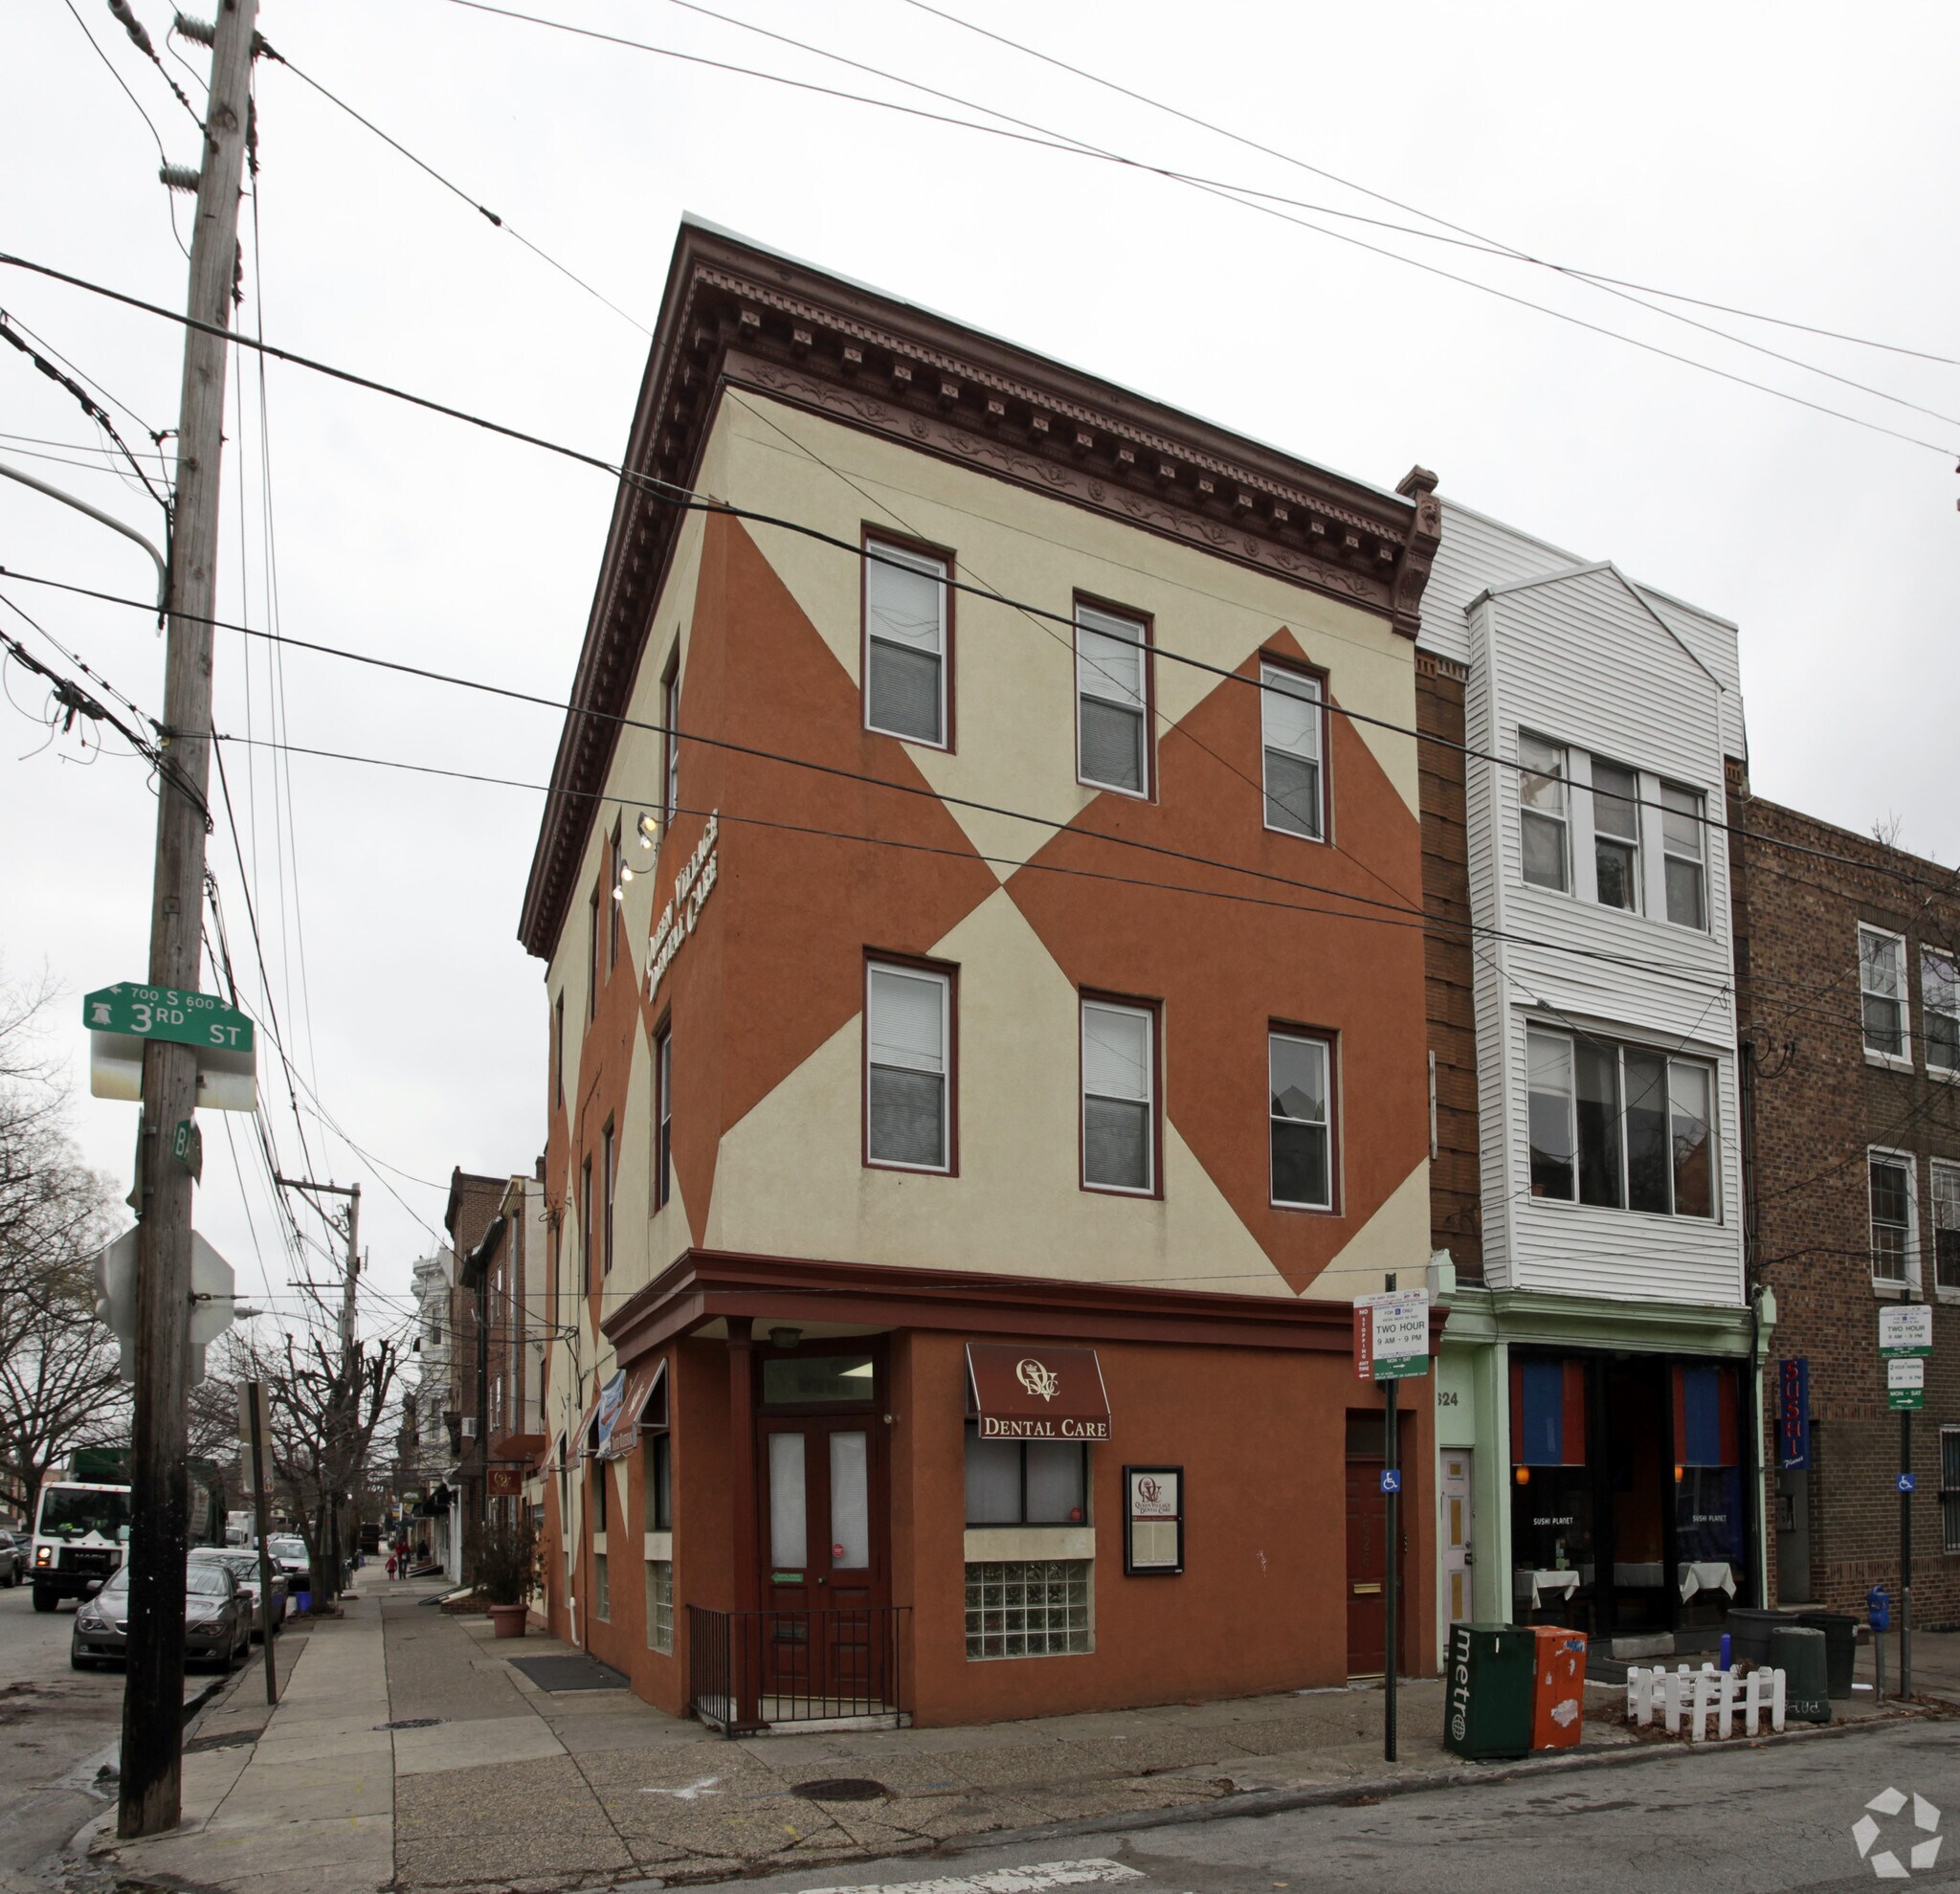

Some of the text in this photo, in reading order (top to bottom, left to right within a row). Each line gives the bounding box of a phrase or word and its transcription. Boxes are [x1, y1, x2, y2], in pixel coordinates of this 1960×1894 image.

[131, 988, 214, 1010] 700 S 600
[130, 1004, 241, 1046] 3RD ST
[1376, 1321, 1425, 1333] TWO HOUR
[1786, 1360, 1801, 1456] SUSHI
[984, 1417, 1107, 1437] DENTAL CARE
[1452, 1629, 1470, 1741] metro
